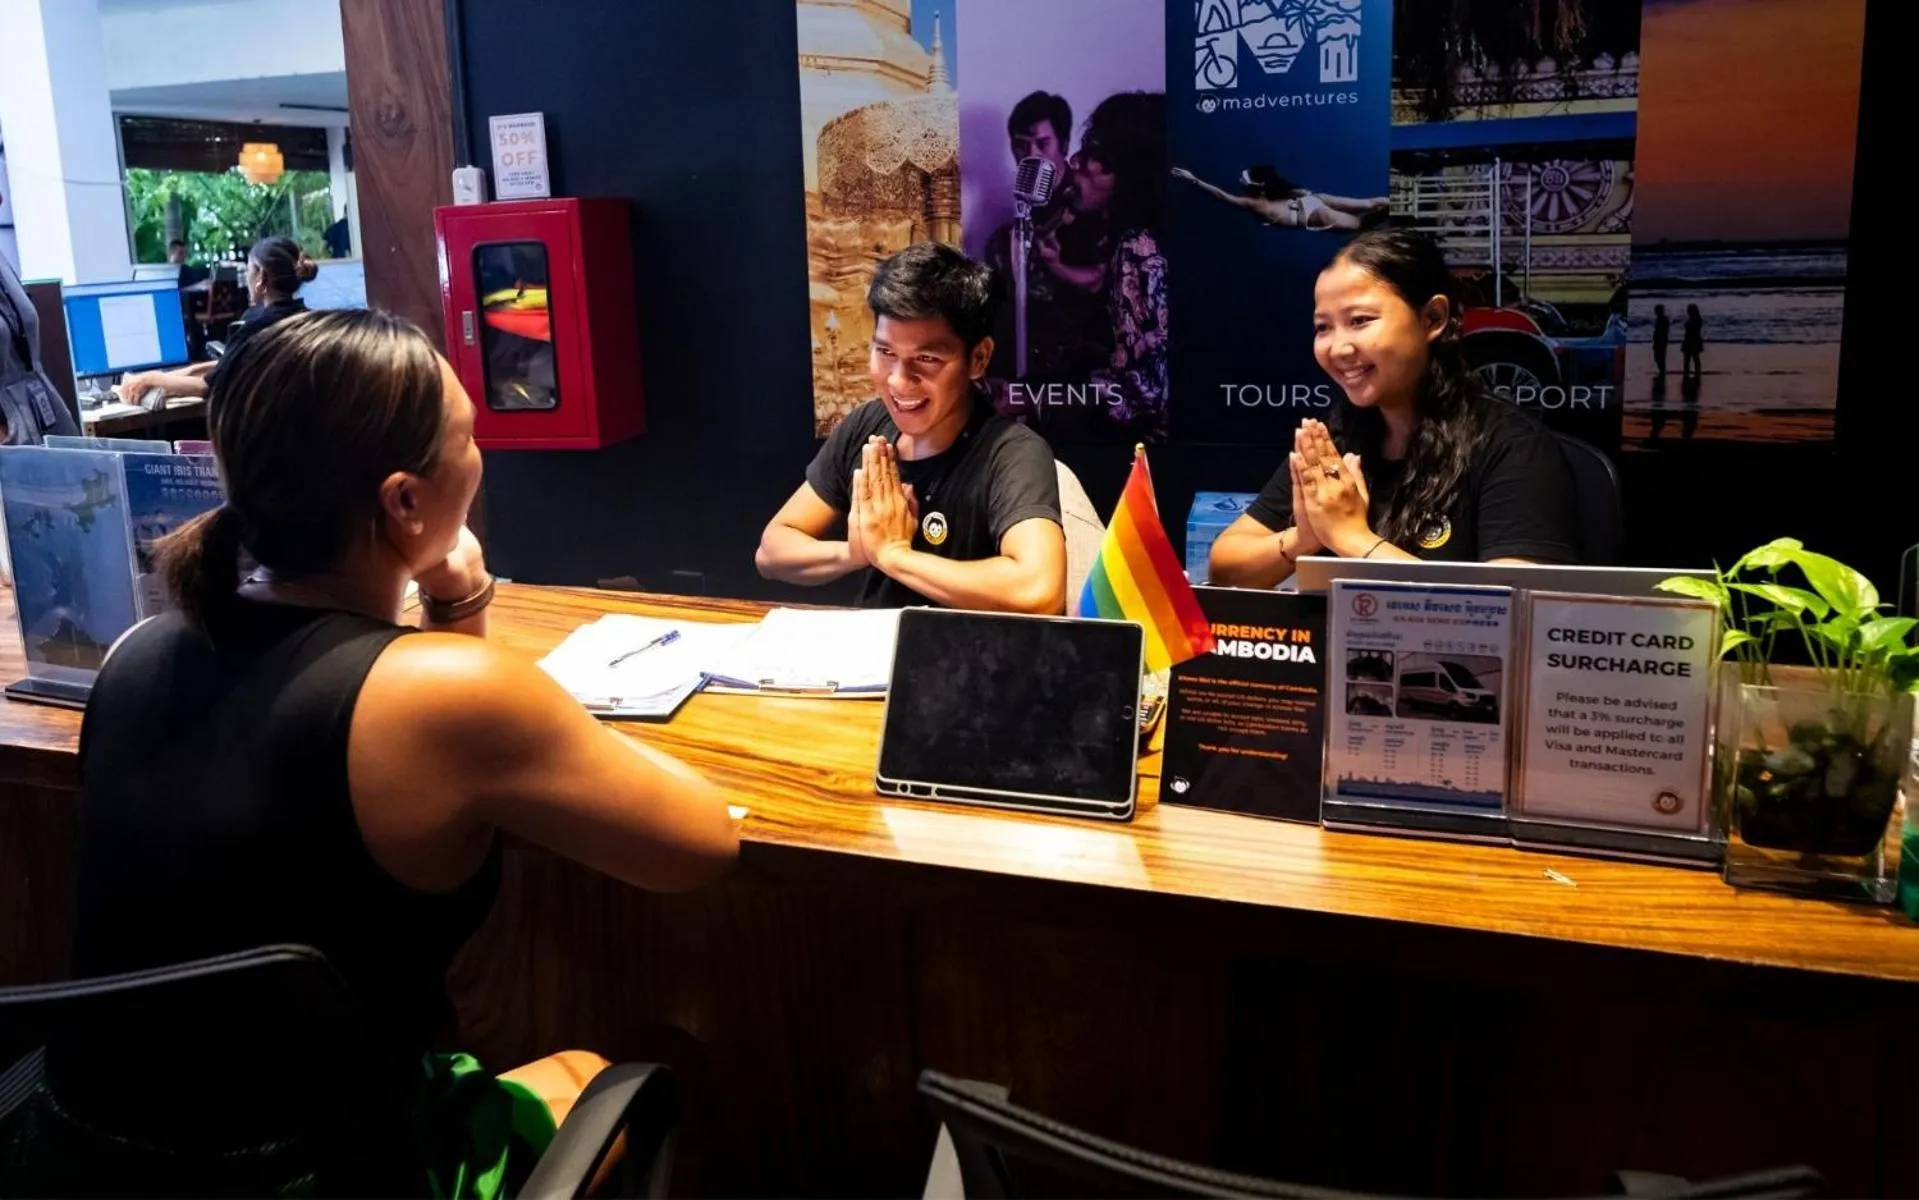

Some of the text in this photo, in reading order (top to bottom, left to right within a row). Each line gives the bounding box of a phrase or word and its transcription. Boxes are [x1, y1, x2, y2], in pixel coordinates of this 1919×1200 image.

[1223, 92, 1358, 110] madventures
[499, 131, 535, 146] 50%
[502, 150, 537, 167] OFF
[1008, 383, 1123, 405] EVENTS
[1220, 384, 1331, 407] TOURS
[144, 464, 172, 475] GIANT
[1291, 629, 1311, 643] IN
[1547, 628, 1695, 650] CREDIT CARD
[1210, 639, 1316, 664] MBODIA
[1547, 653, 1691, 677] SURCHARGE
[1556, 691, 1678, 711] Please be advised
[1548, 708, 1576, 720] that
[1579, 712, 1587, 720] a
[1614, 714, 1685, 729] surcharge
[1545, 725, 1685, 744] will be applied to all
[1545, 739, 1683, 761] Visa and Mastercard
[1569, 759, 1656, 776] transactions.
